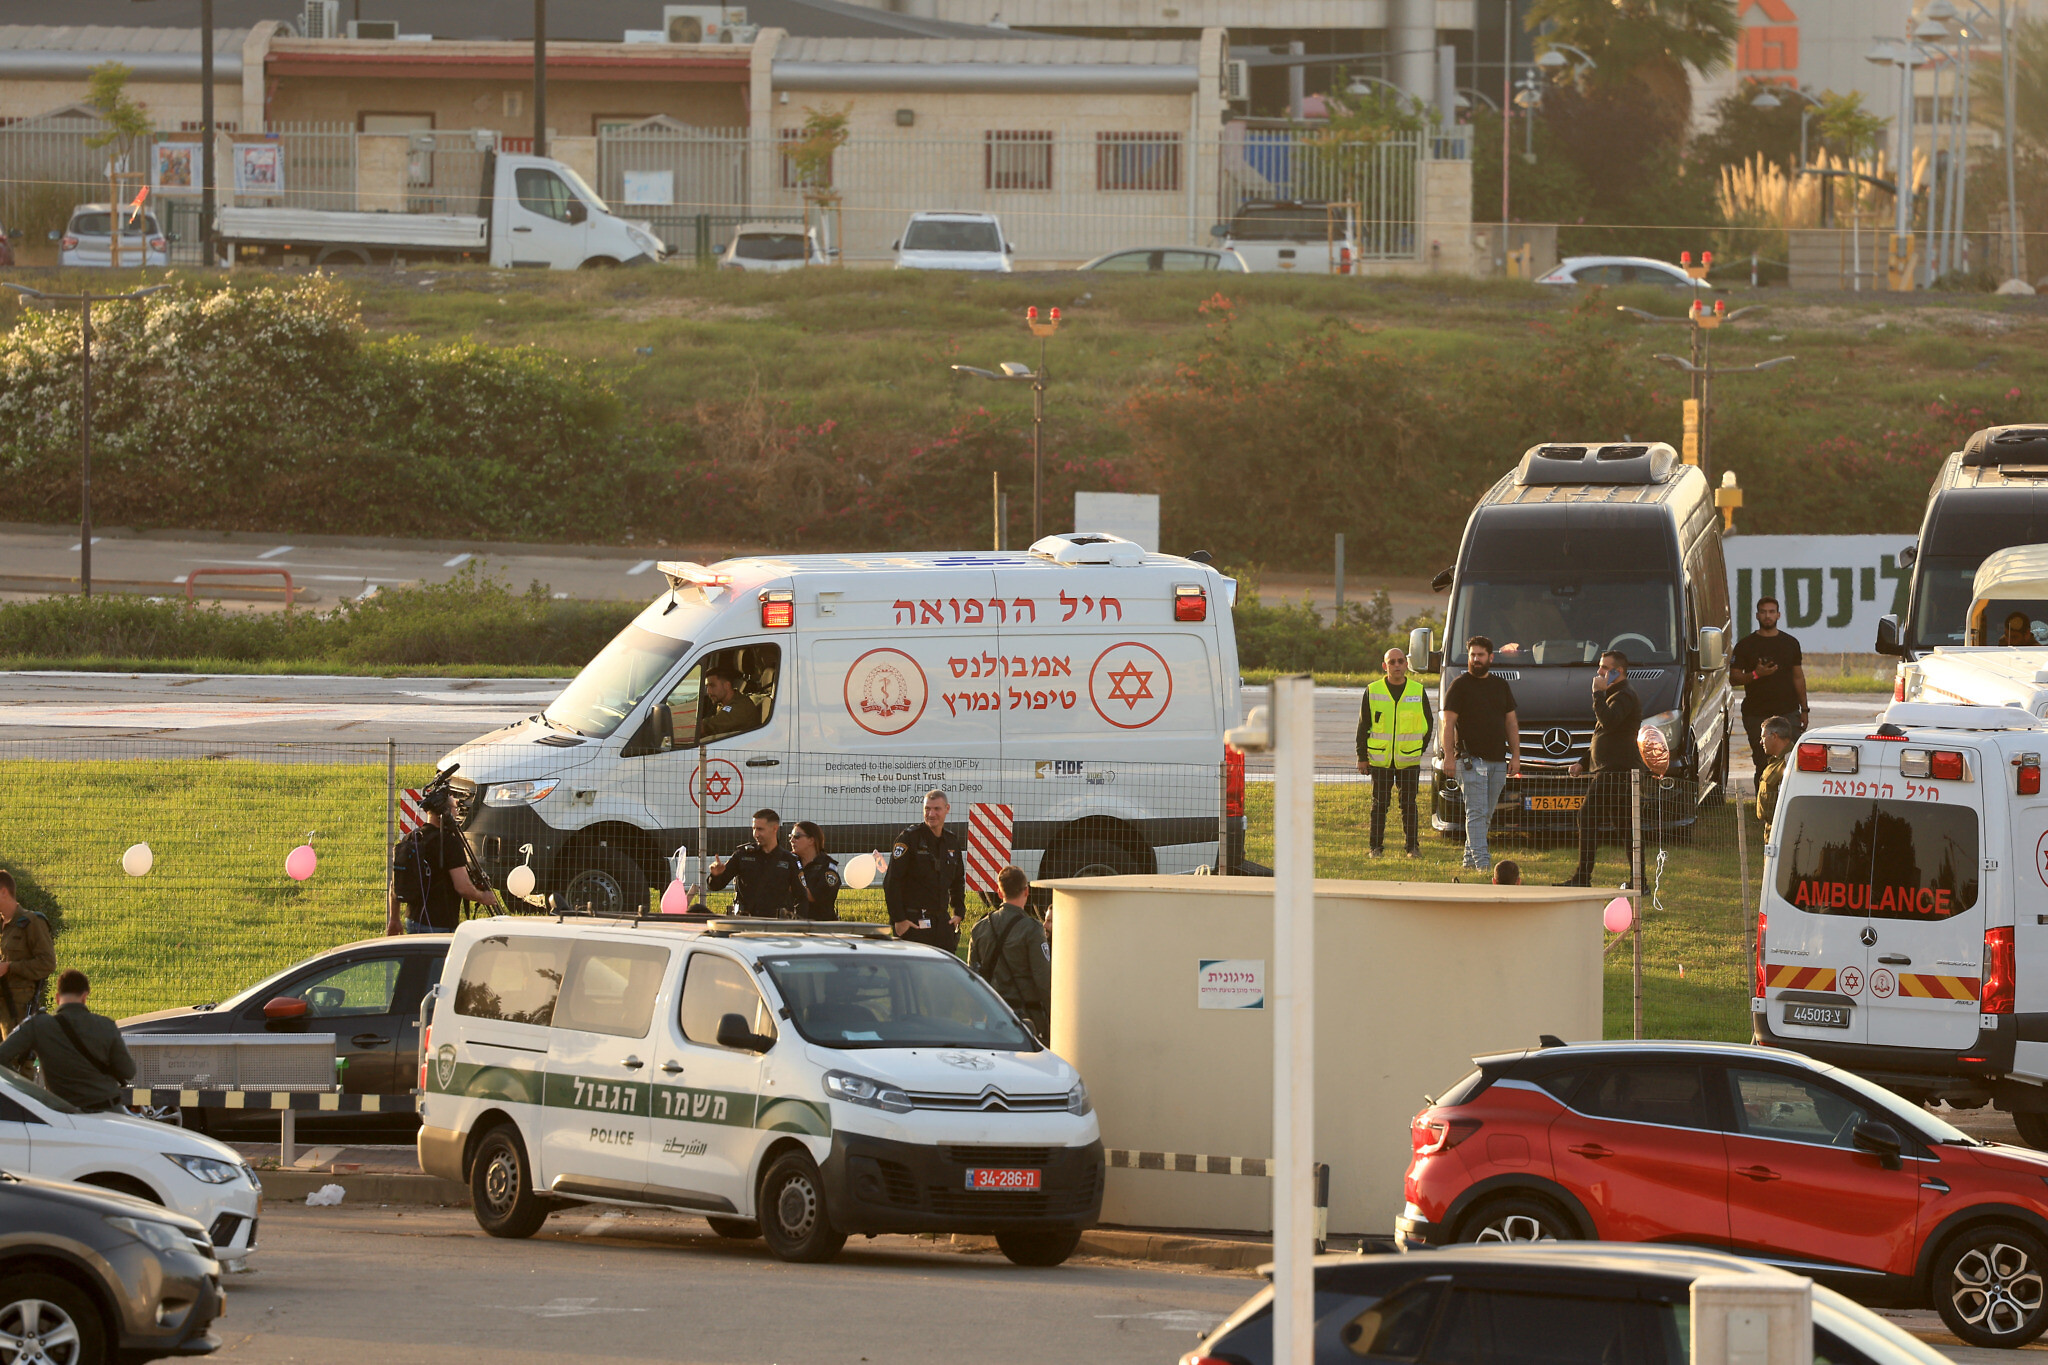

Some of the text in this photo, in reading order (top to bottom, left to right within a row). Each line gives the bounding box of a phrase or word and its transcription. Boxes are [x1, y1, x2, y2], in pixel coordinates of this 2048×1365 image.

[892, 588, 1122, 625] חיל הרפואה
[948, 650, 1072, 679] אמבולנס
[942, 686, 1077, 718] טיפול נמרץ
[825, 759, 980, 771] Dedicated to the soldiers of the IDF by
[1055, 760, 1083, 775] FIDF
[860, 771, 946, 782] The Lou Dunst Trust
[823, 785, 838, 795] The
[840, 784, 871, 794] Friends
[872, 784, 881, 793] of
[882, 784, 896, 793] the
[899, 784, 912, 793] IDF
[941, 783, 957, 792] San
[959, 783, 983, 793] Diego
[1822, 779, 1940, 801] חיל הרפואה
[875, 795, 925, 805] October 202
[1794, 880, 1952, 915] AMBULANCE
[1208, 972, 1255, 983] מיגונית
[573, 1076, 728, 1120] משמר הגבול
[589, 1127, 635, 1146] POLICE
[662, 1136, 708, 1158] الشرطة
